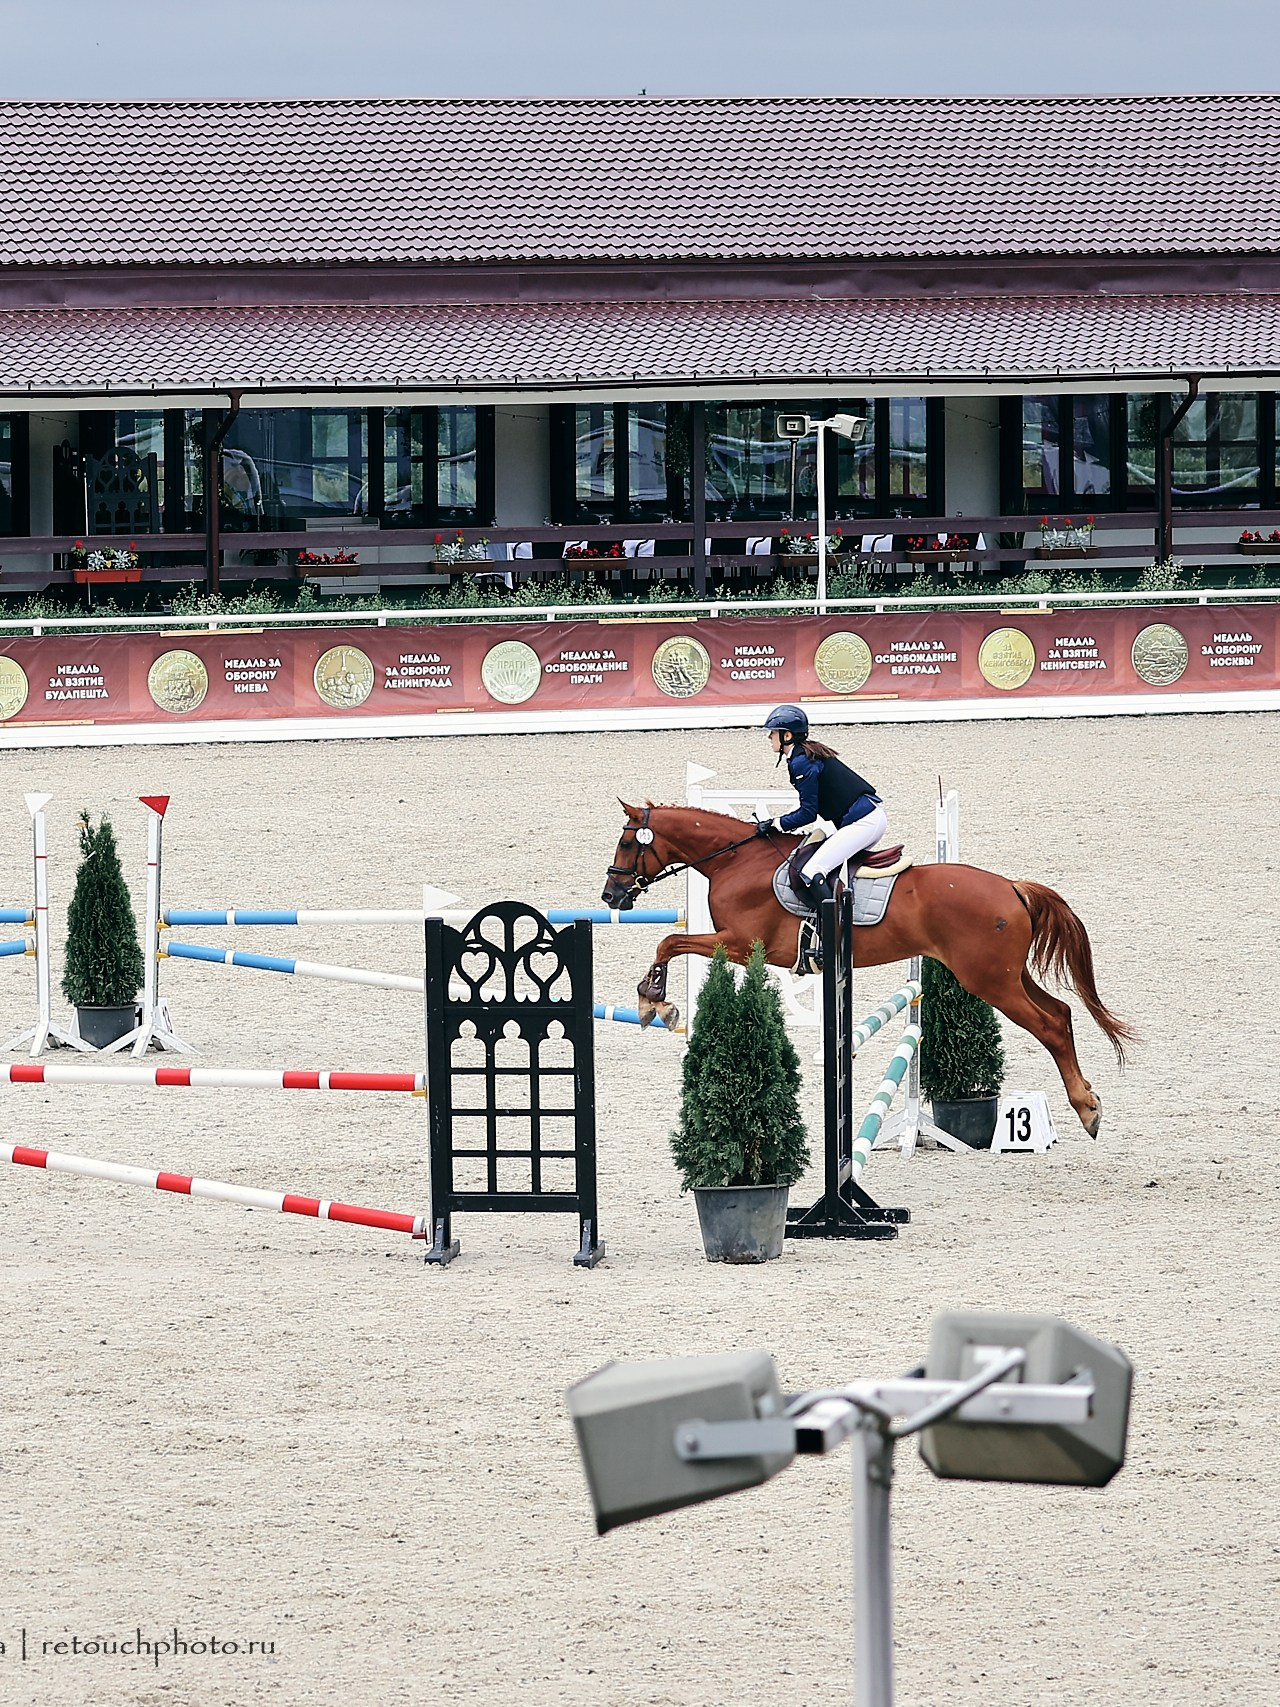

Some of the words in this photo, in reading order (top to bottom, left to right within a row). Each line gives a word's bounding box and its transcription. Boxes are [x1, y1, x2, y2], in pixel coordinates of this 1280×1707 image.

[1055, 637, 1095, 647] МЕДАЛЬ
[1213, 632, 1253, 643] МЕДАЛЬ
[734, 645, 775, 656] МЕДАЛЬ
[890, 641, 931, 652] МЕДАЛЬ
[932, 641, 945, 650] ЗА
[1201, 645, 1214, 655] ЗА
[1215, 644, 1263, 655] ОБОРОНУ
[399, 653, 441, 664] МЕДАЛЬ
[560, 650, 601, 661] МЕДАЛЬ
[602, 650, 616, 659] ЗА
[874, 652, 957, 664] ОСВОБОЖДЕНИЕ
[1048, 649, 1061, 659] ЗА
[1062, 648, 1098, 658] ВЗЯТИЕ
[224, 658, 267, 669] МЕДАЛЬ
[268, 658, 282, 668] ЗА
[497, 660, 526, 670] ПРАГИ
[545, 661, 628, 673] ОСВОБОЖДЕНИЕ
[721, 658, 734, 668] ЗА
[735, 657, 785, 668] ОБОРОНУ
[1040, 660, 1107, 671] КЕНИГСБЕРГА
[1210, 656, 1254, 667] МОСКВЫ
[57, 664, 100, 675] МЕДАЛЬ
[385, 667, 399, 676] ЗА
[400, 665, 451, 676] ОБОРОНУ
[730, 669, 775, 681] ОДЕССЫ
[891, 664, 941, 675] БЕЛГРАДА
[225, 670, 277, 681] ОБОРОНУ
[570, 674, 603, 684] ПРАГИ
[49, 678, 64, 688] ЗА
[65, 676, 104, 687] ВЗЯТИЕ
[384, 677, 453, 689] ЛЕНИНГРАДА
[234, 683, 269, 693] КИЕВА
[45, 688, 109, 701] БУДАПЕШТА
[1005, 1107, 1031, 1142] 13
